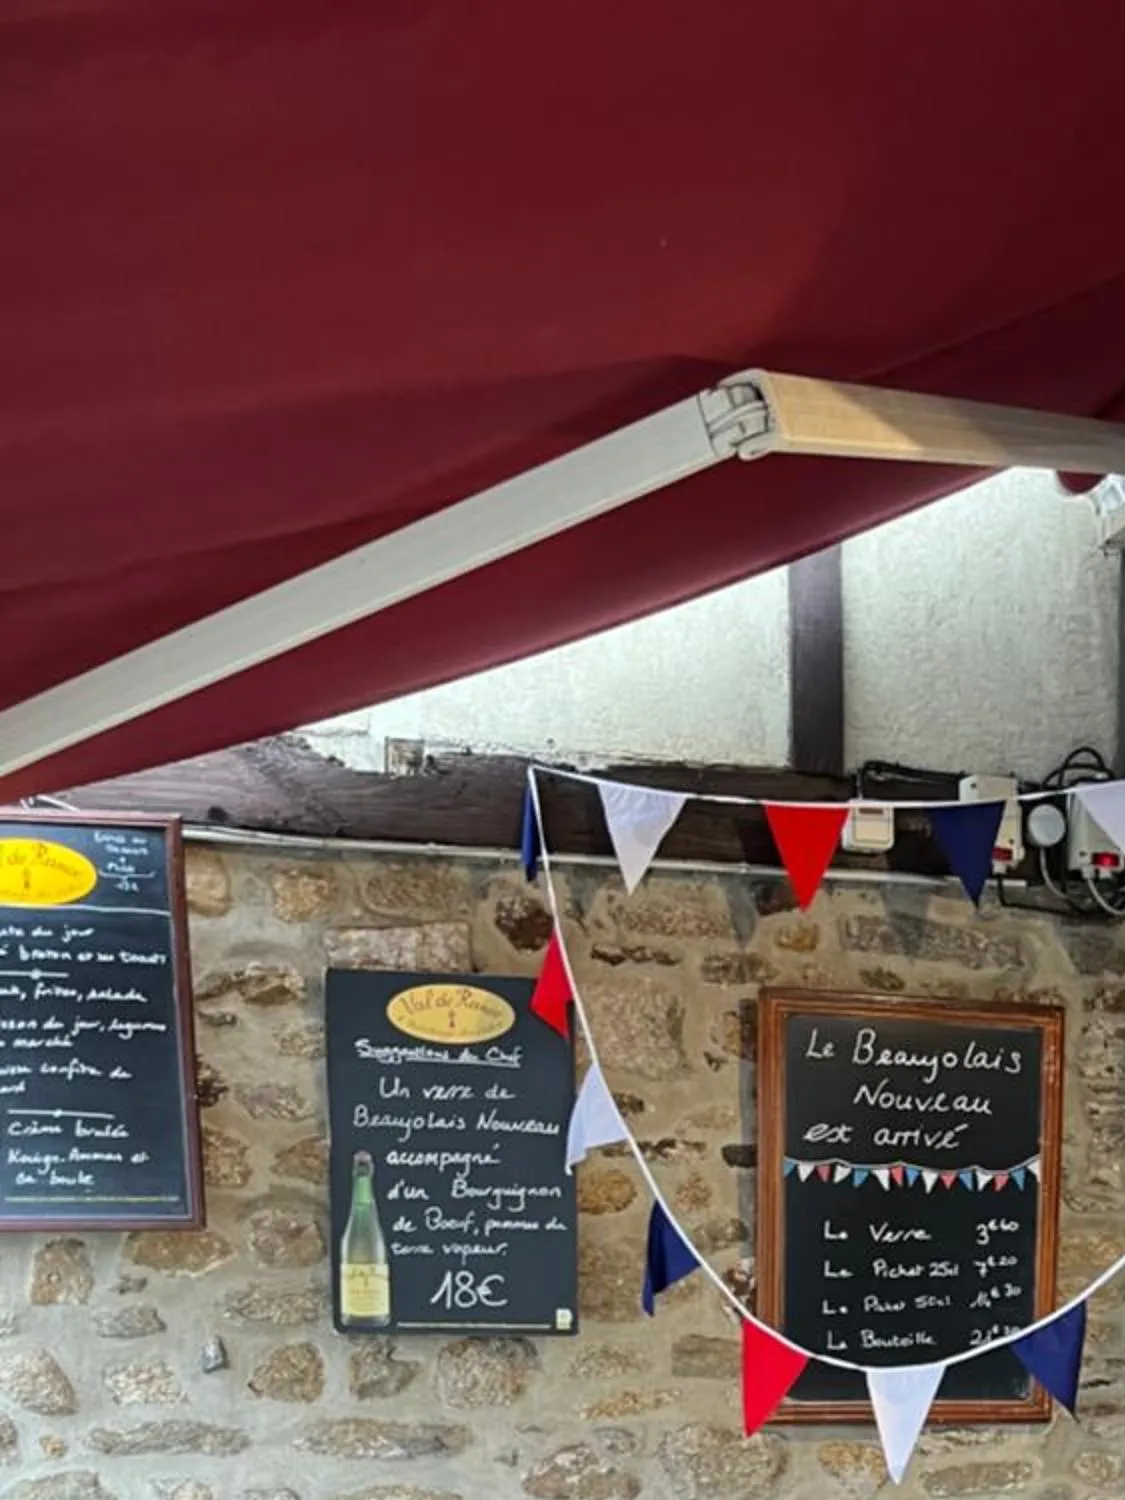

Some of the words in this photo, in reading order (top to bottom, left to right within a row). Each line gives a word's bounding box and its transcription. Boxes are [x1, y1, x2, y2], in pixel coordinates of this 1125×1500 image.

[806, 1027, 836, 1058] Le
[379, 1076, 410, 1098] Un
[423, 1084, 475, 1100] verre
[484, 1083, 515, 1099] de
[853, 1078, 993, 1116] Nouveau
[353, 1103, 467, 1142] Beaujolais
[476, 1108, 560, 1135] Nouveau
[802, 1122, 853, 1144] est
[873, 1122, 970, 1150] arrivé
[386, 1143, 502, 1179] accompagné
[450, 1178, 563, 1213] Bourguignon
[392, 1216, 418, 1232] de
[824, 1219, 848, 1240] Le
[869, 1221, 932, 1243] Verre
[823, 1259, 854, 1278] Le
[430, 1270, 508, 1310] 18€
[821, 1299, 849, 1315] Le
